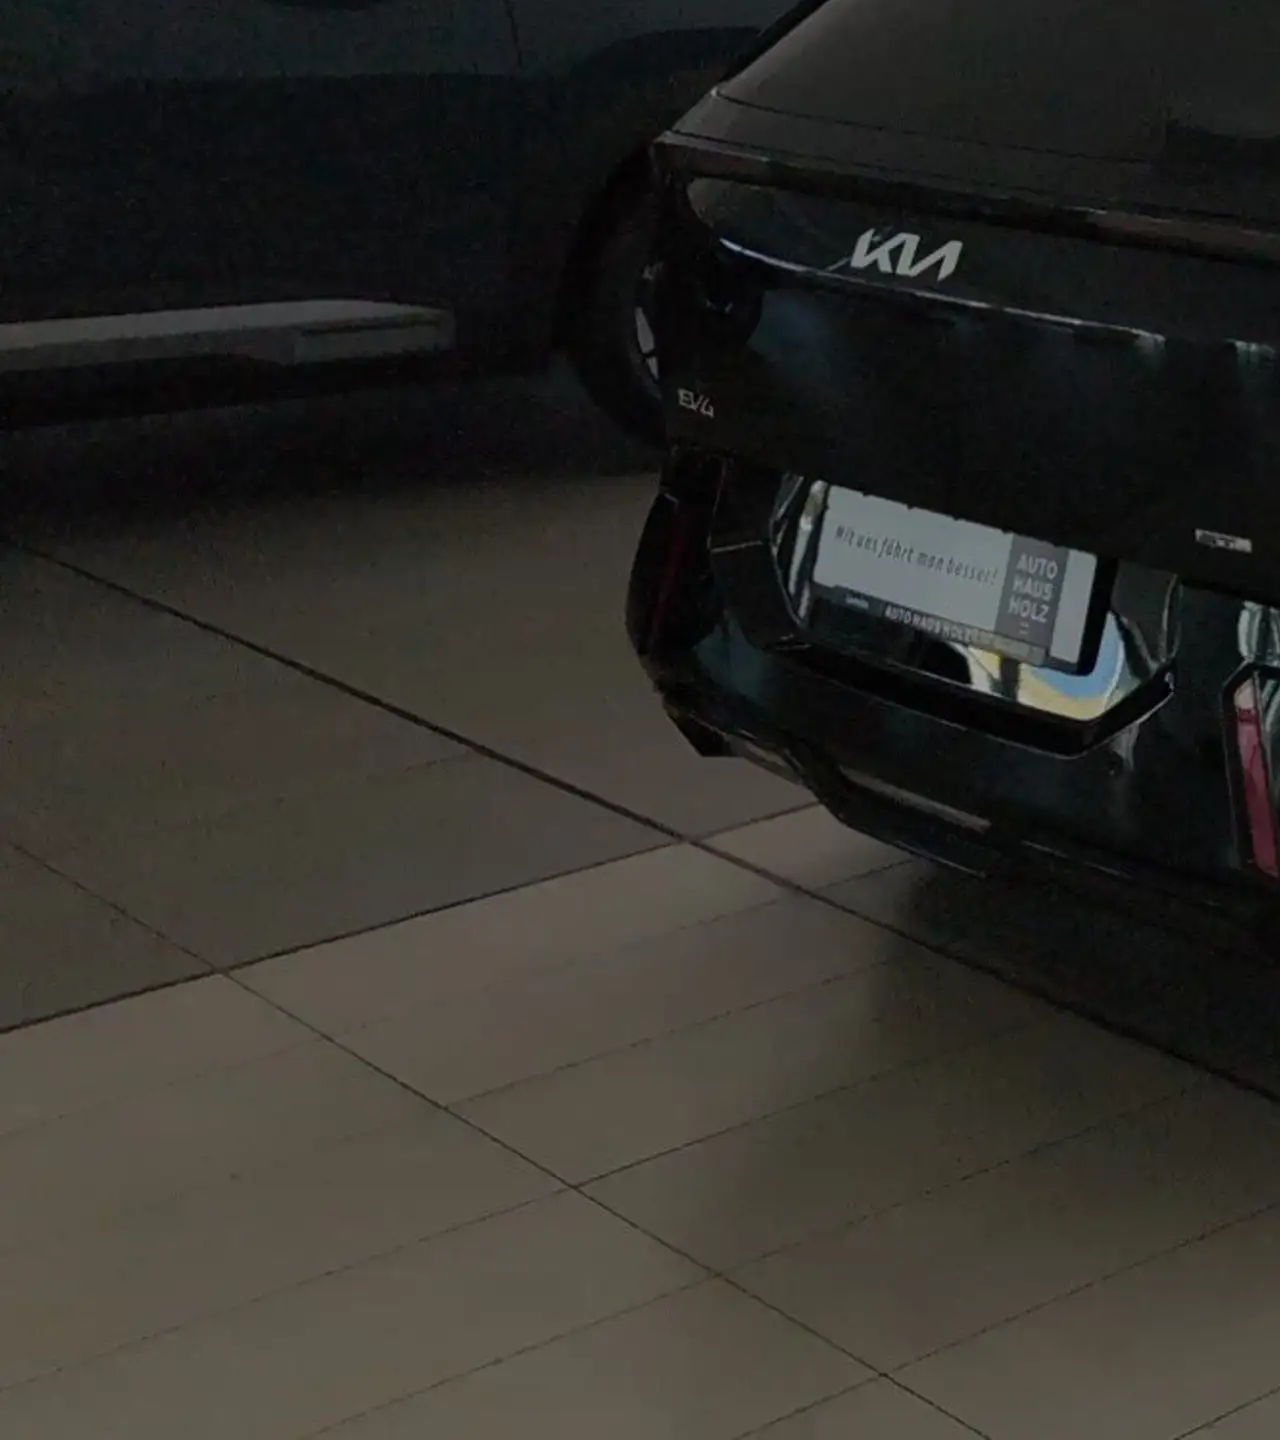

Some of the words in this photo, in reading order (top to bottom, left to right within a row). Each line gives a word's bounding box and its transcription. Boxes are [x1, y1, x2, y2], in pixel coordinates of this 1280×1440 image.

[850, 228, 963, 282] KIA
[677, 387, 714, 419] EV4
[1015, 554, 1058, 577] AUTO
[1012, 576, 1053, 598] HAUS
[884, 605, 911, 623] AUTO
[1008, 597, 1049, 621] HOLZ
